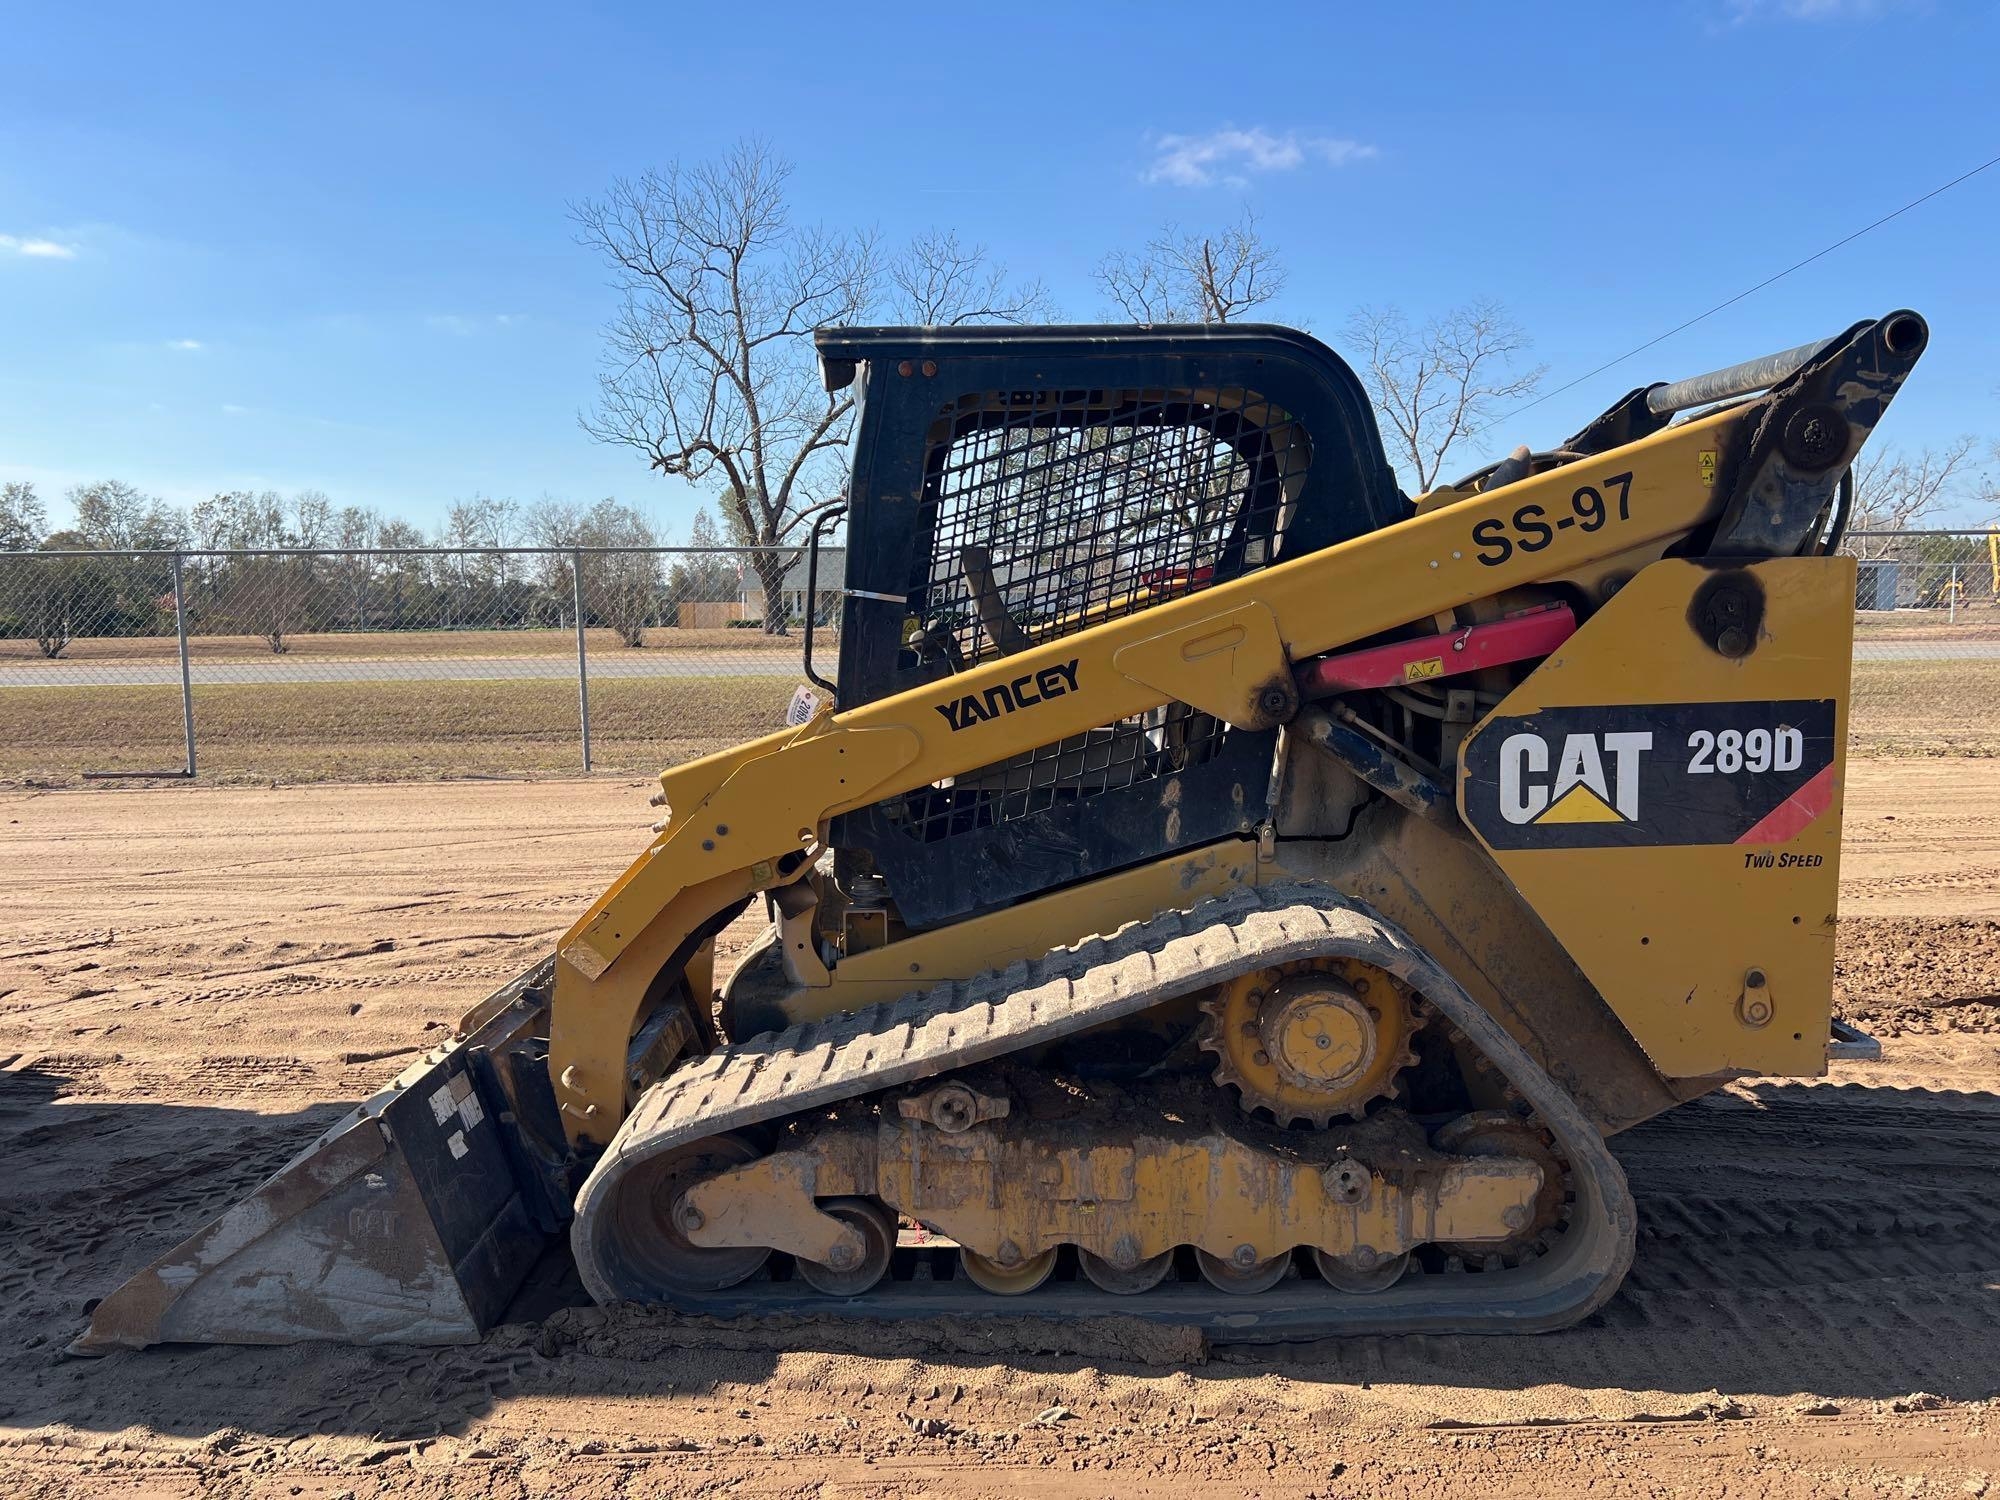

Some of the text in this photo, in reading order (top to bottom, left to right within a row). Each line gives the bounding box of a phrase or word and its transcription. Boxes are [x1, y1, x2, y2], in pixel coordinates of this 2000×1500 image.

[1471, 470, 1635, 567] SS-97
[934, 658, 1081, 732] YANCEY
[1499, 731, 1654, 825] CAT
[1687, 727, 1804, 774] 289D
